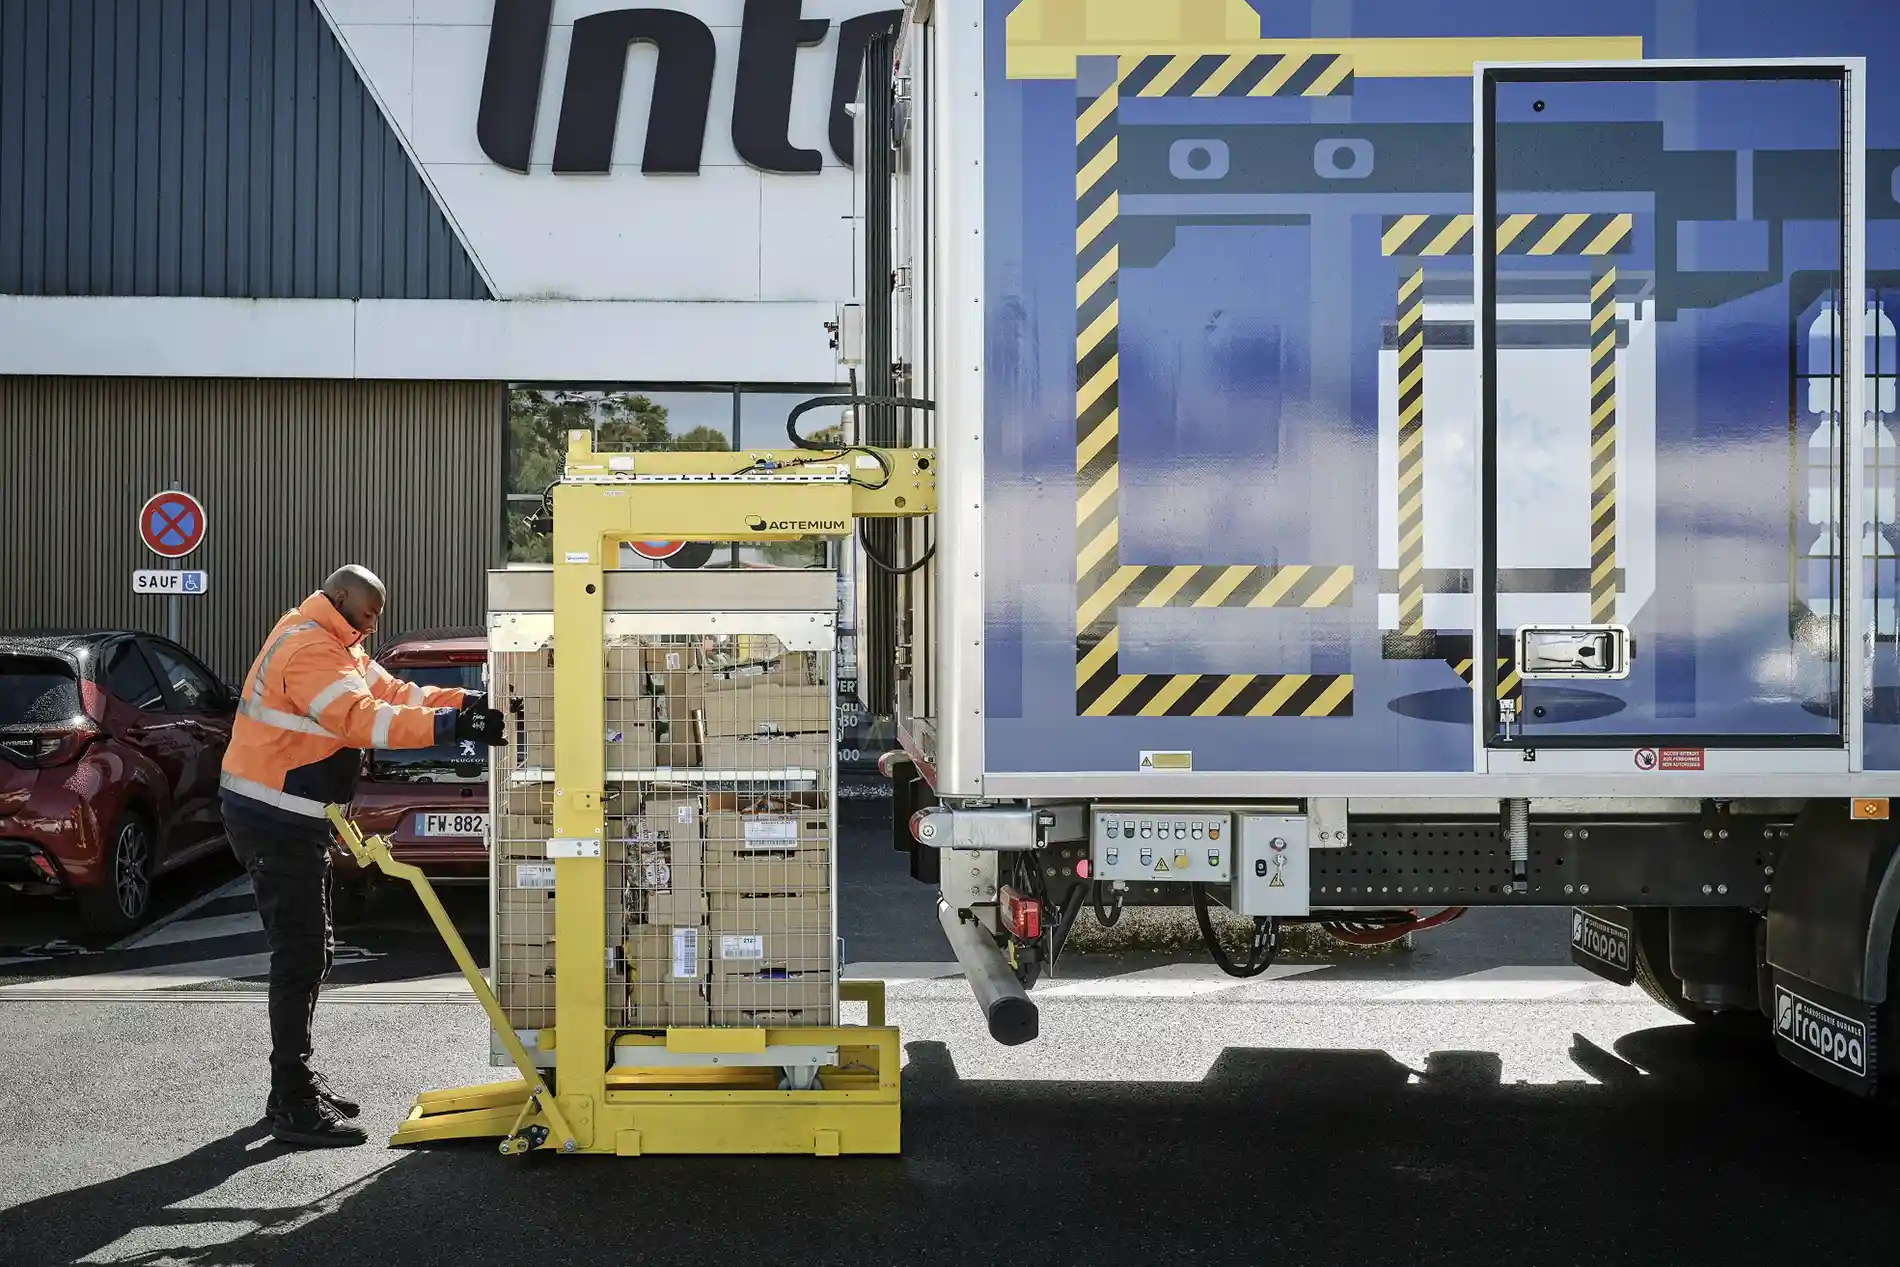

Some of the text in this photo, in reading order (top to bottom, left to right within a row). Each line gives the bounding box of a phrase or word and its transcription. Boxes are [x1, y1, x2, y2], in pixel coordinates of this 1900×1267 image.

[769, 520, 845, 530] ACTEMIUM
[138, 575, 178, 588] SAUF
[1584, 918, 1627, 964] frappa
[1795, 1002, 1862, 1068] frappa
[1803, 1004, 1862, 1037] CARROSSERIE DURABLE
